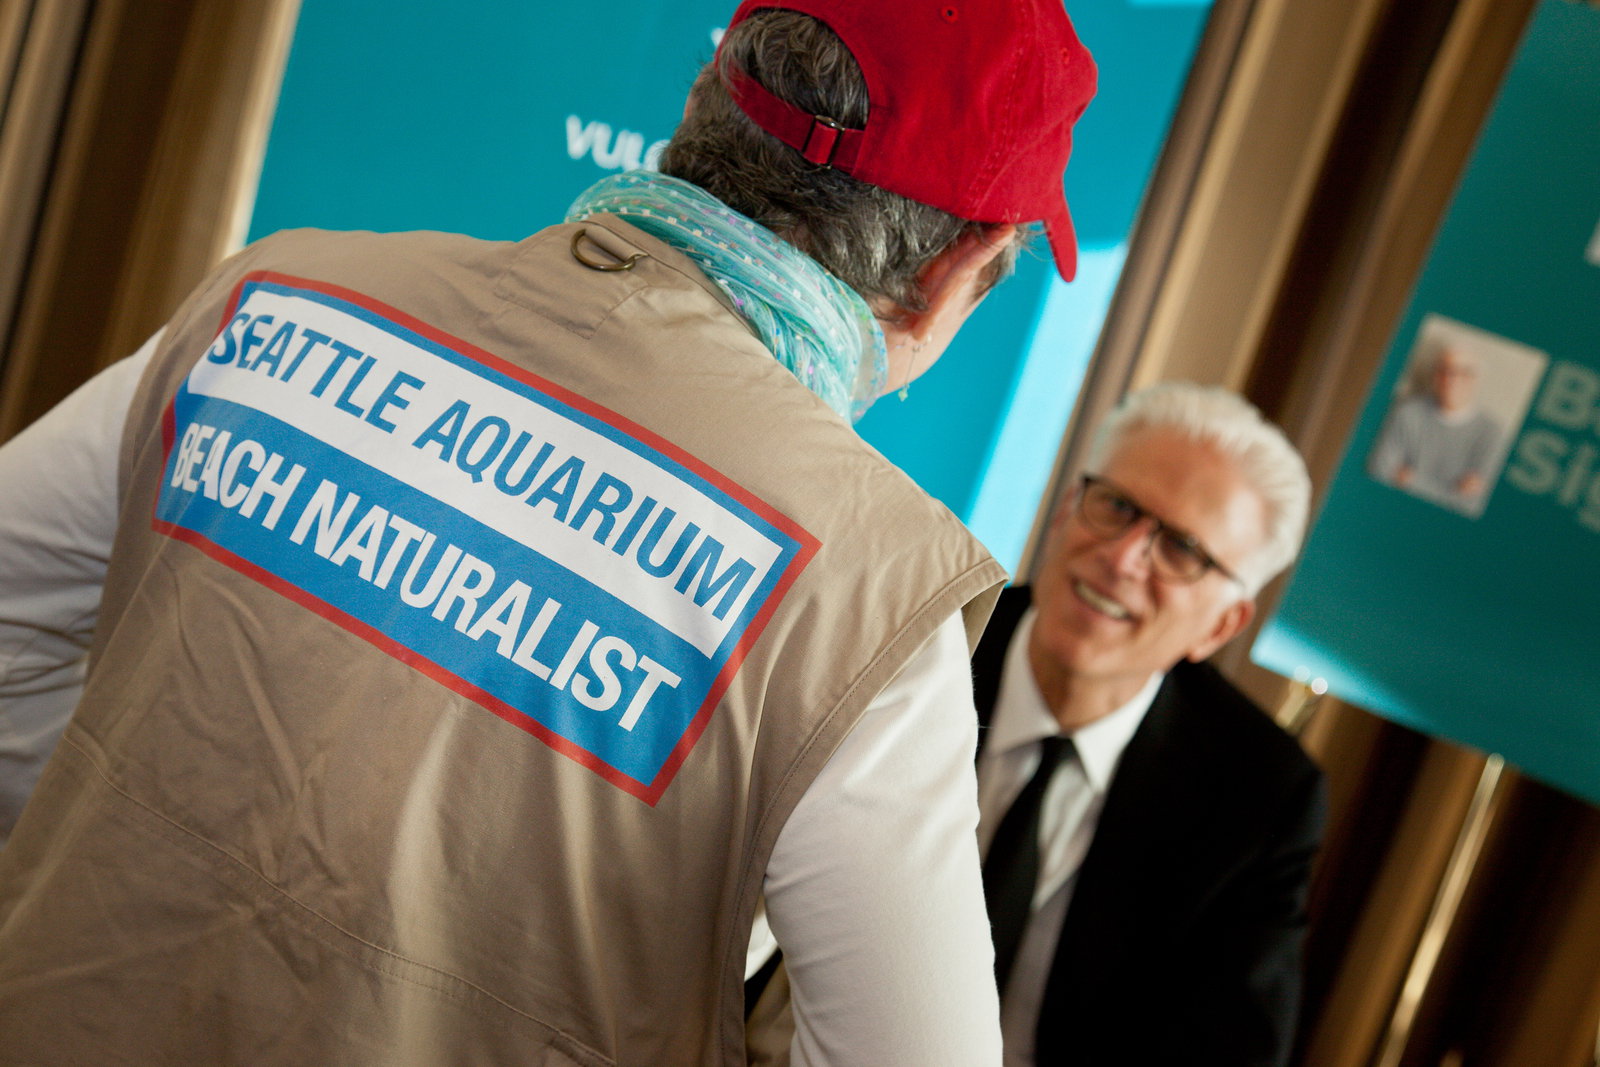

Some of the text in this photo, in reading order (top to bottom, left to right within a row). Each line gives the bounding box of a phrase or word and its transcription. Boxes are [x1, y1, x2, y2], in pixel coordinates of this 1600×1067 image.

[171, 422, 682, 732] BEACH NATURALIST
[207, 312, 757, 622] SEATTLE AQUARIUM
